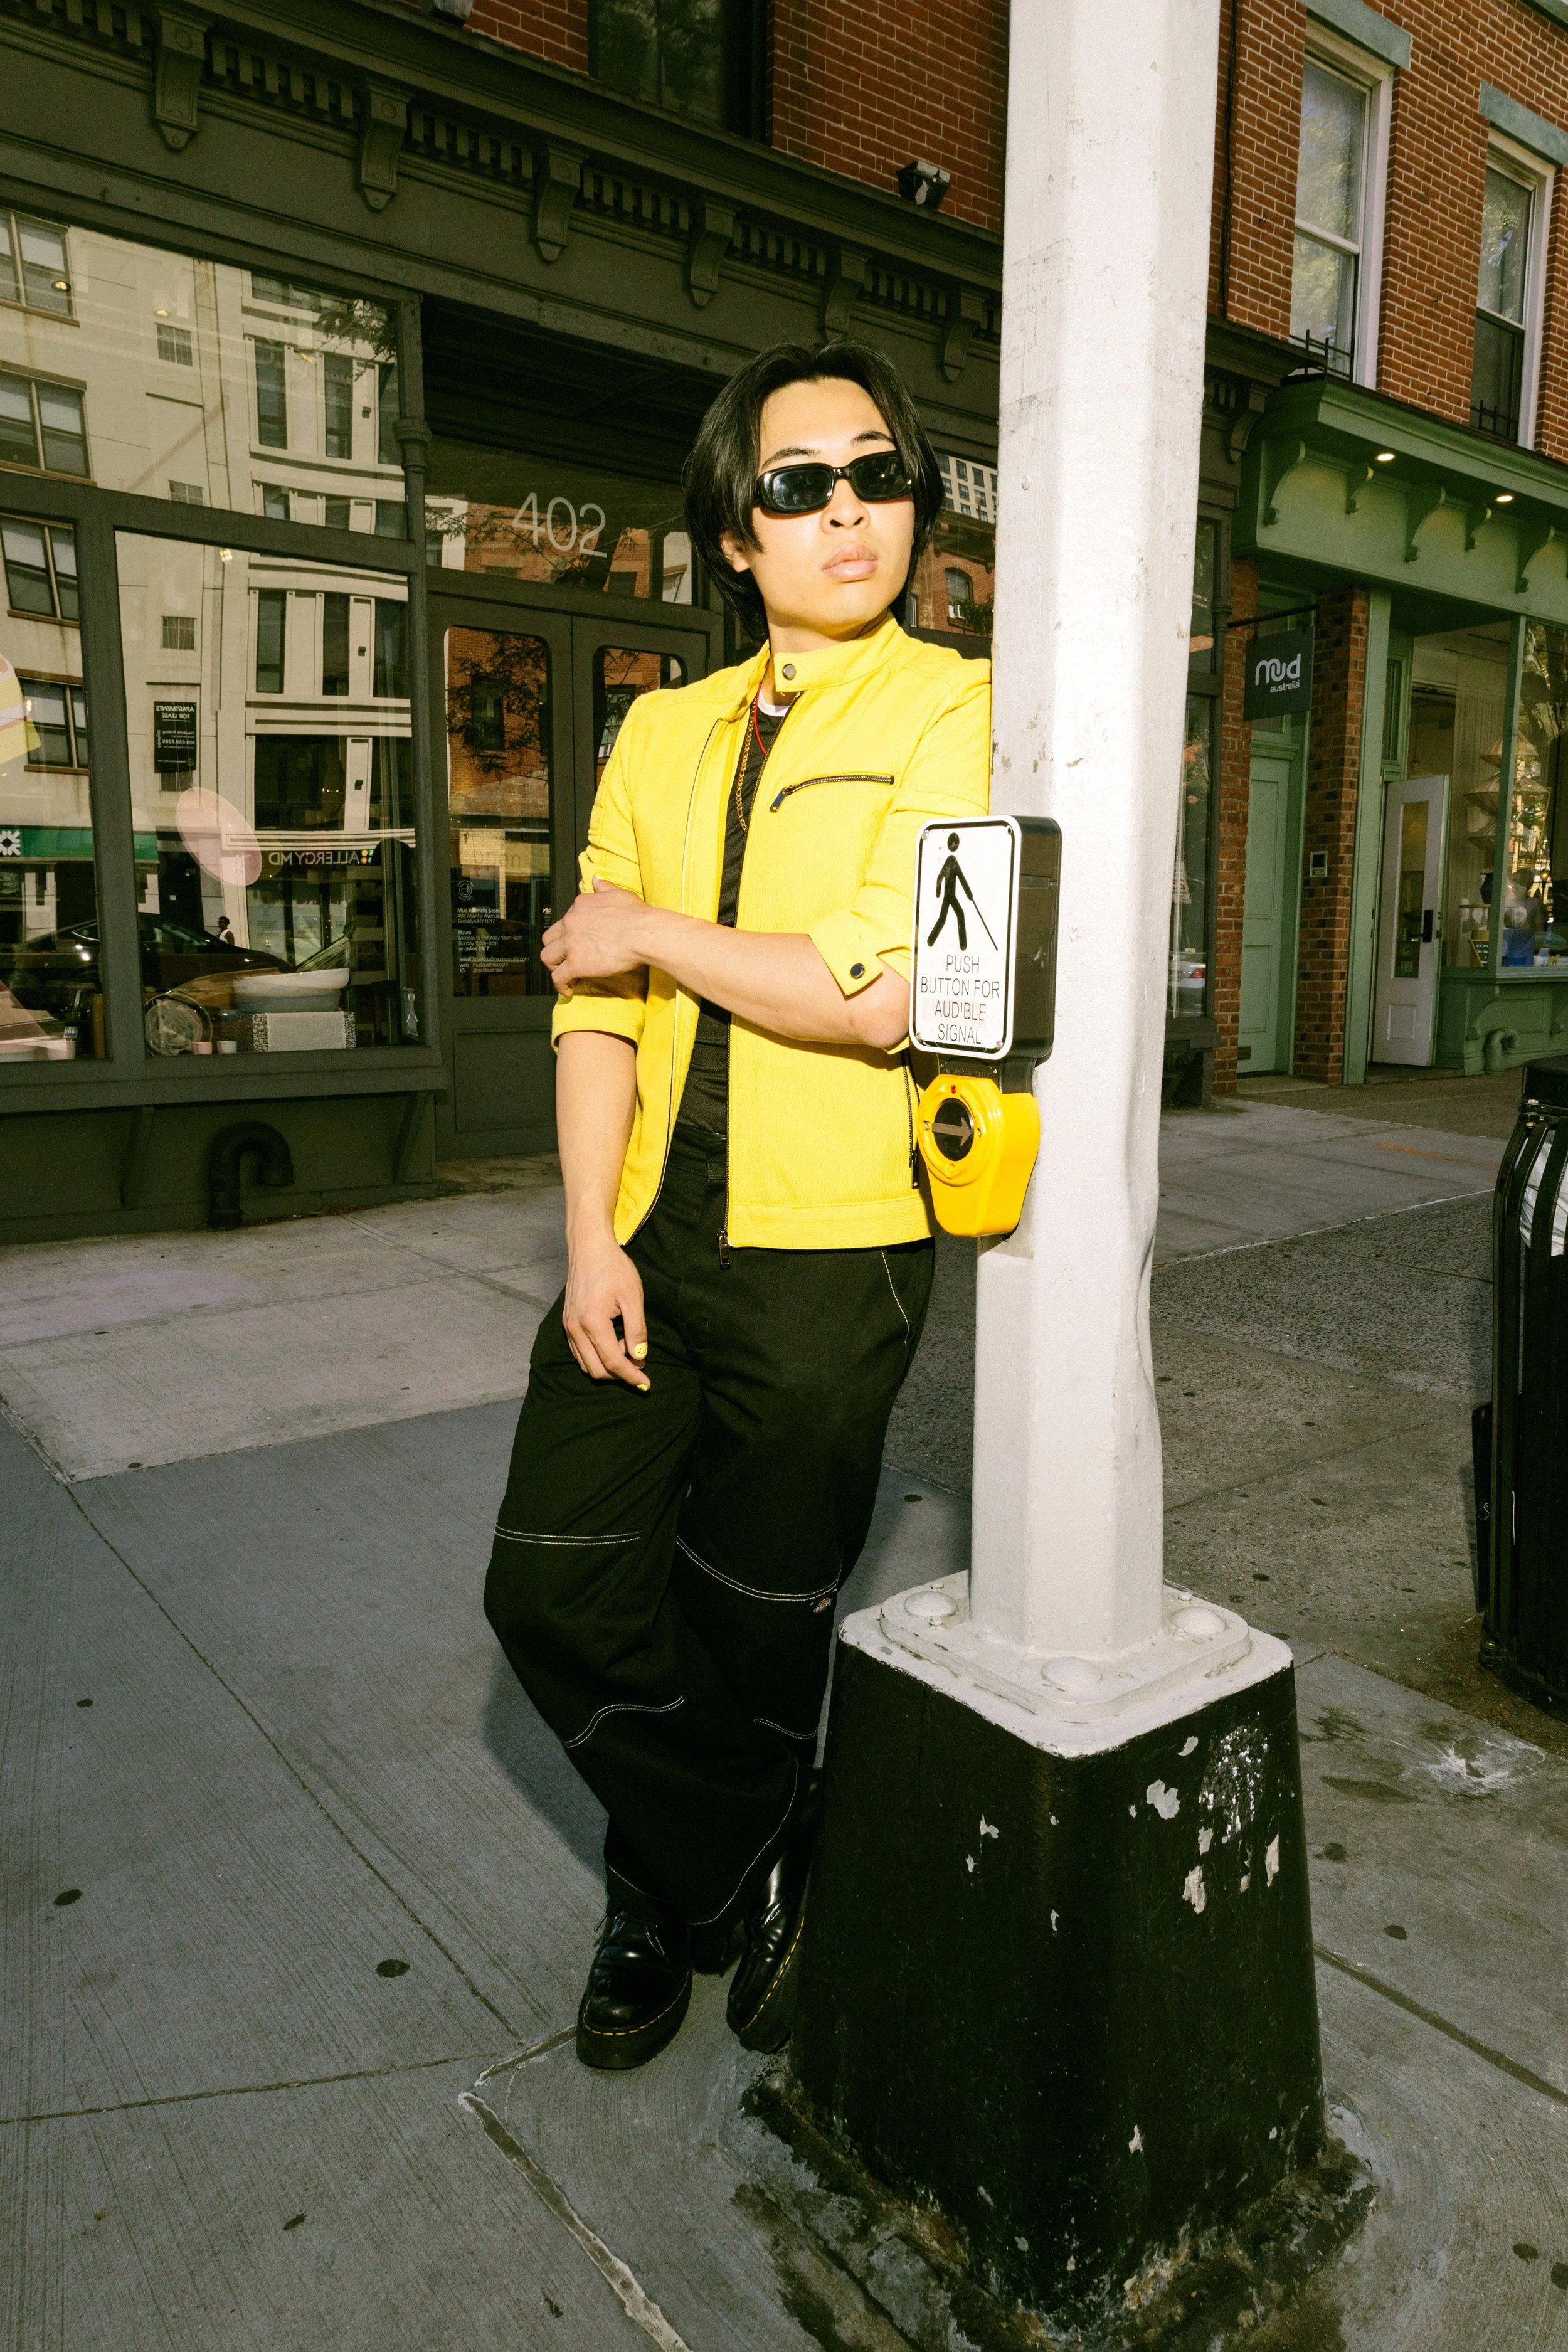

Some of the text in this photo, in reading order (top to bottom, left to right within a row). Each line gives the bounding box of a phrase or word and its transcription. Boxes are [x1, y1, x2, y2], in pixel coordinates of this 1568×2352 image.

[512, 492, 607, 558] 402
[1255, 653, 1301, 686] mud
[1270, 680, 1300, 692] australia
[946, 955, 980, 973] PUSH
[921, 976, 1000, 999] BUTTON FOR
[934, 1000, 987, 1021] AUDIBLE
[938, 1023, 982, 1044] SIGNAL
